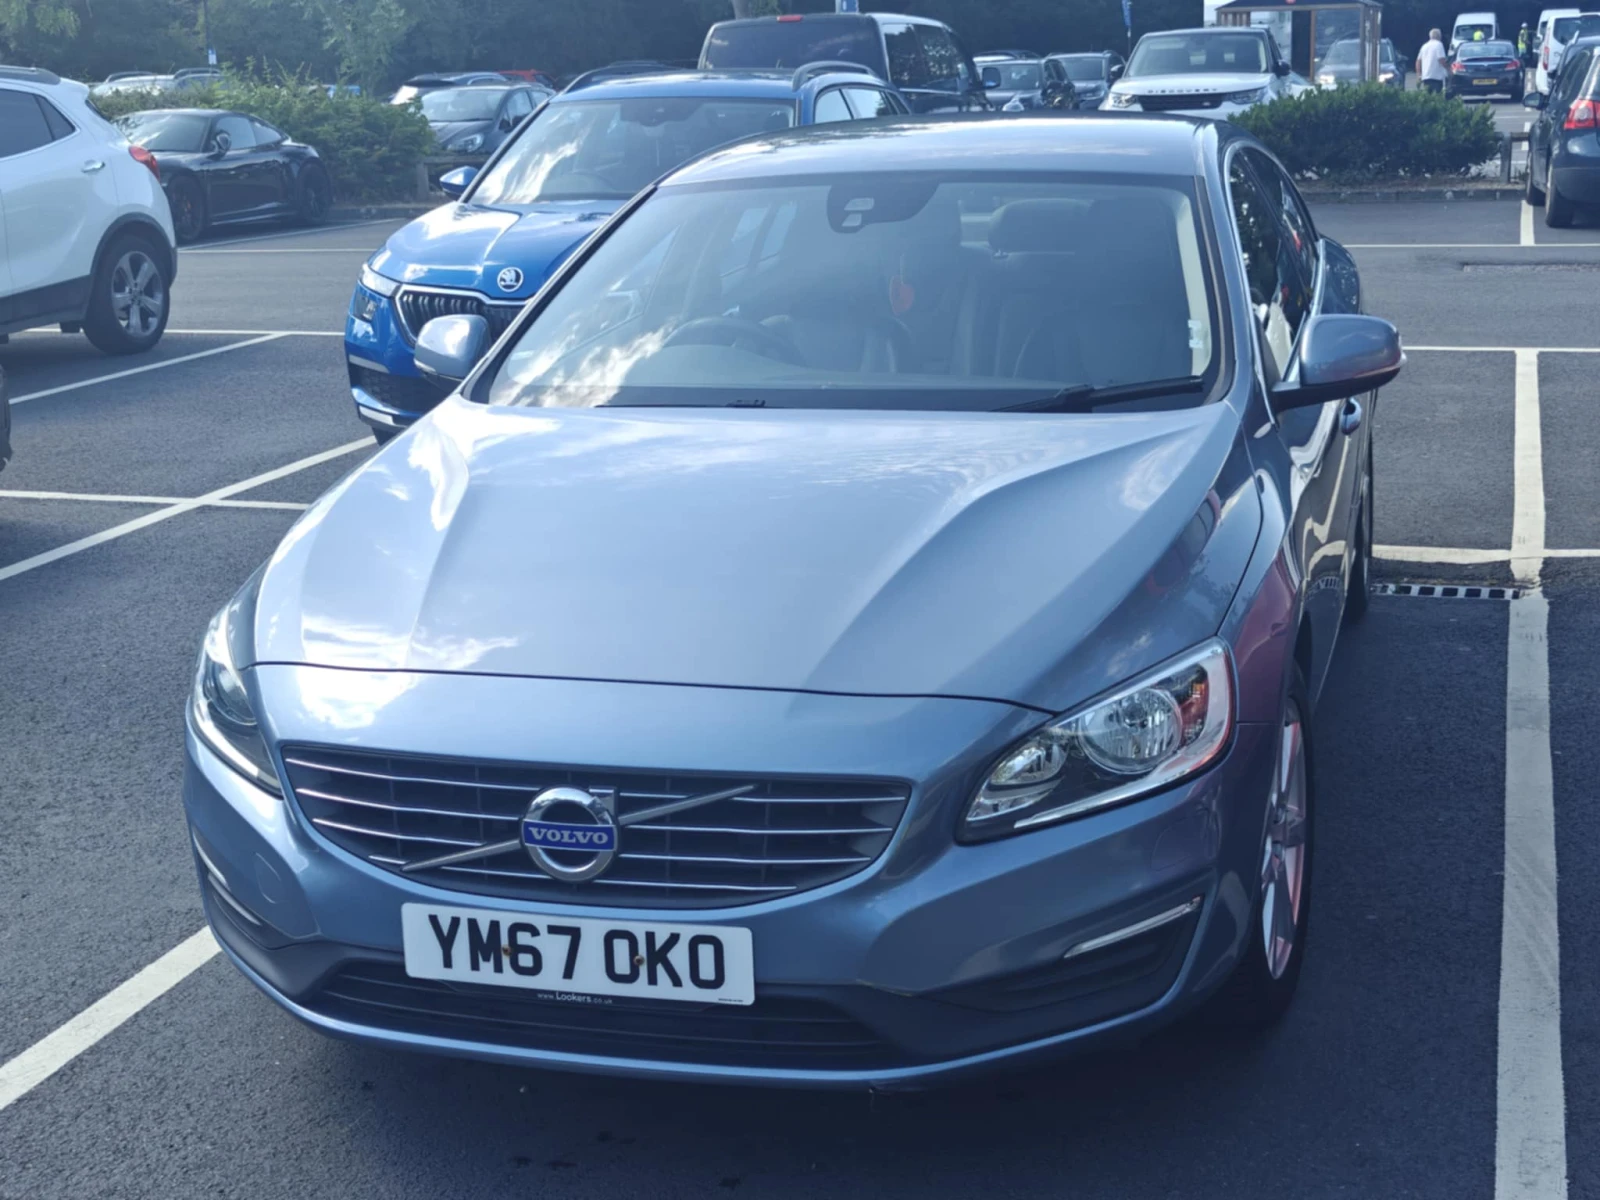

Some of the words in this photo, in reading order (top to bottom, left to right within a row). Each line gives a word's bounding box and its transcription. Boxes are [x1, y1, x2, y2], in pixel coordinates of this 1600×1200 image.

[528, 826, 609, 845] VOLVO
[428, 914, 582, 980] YM67
[603, 929, 726, 990] OKO
